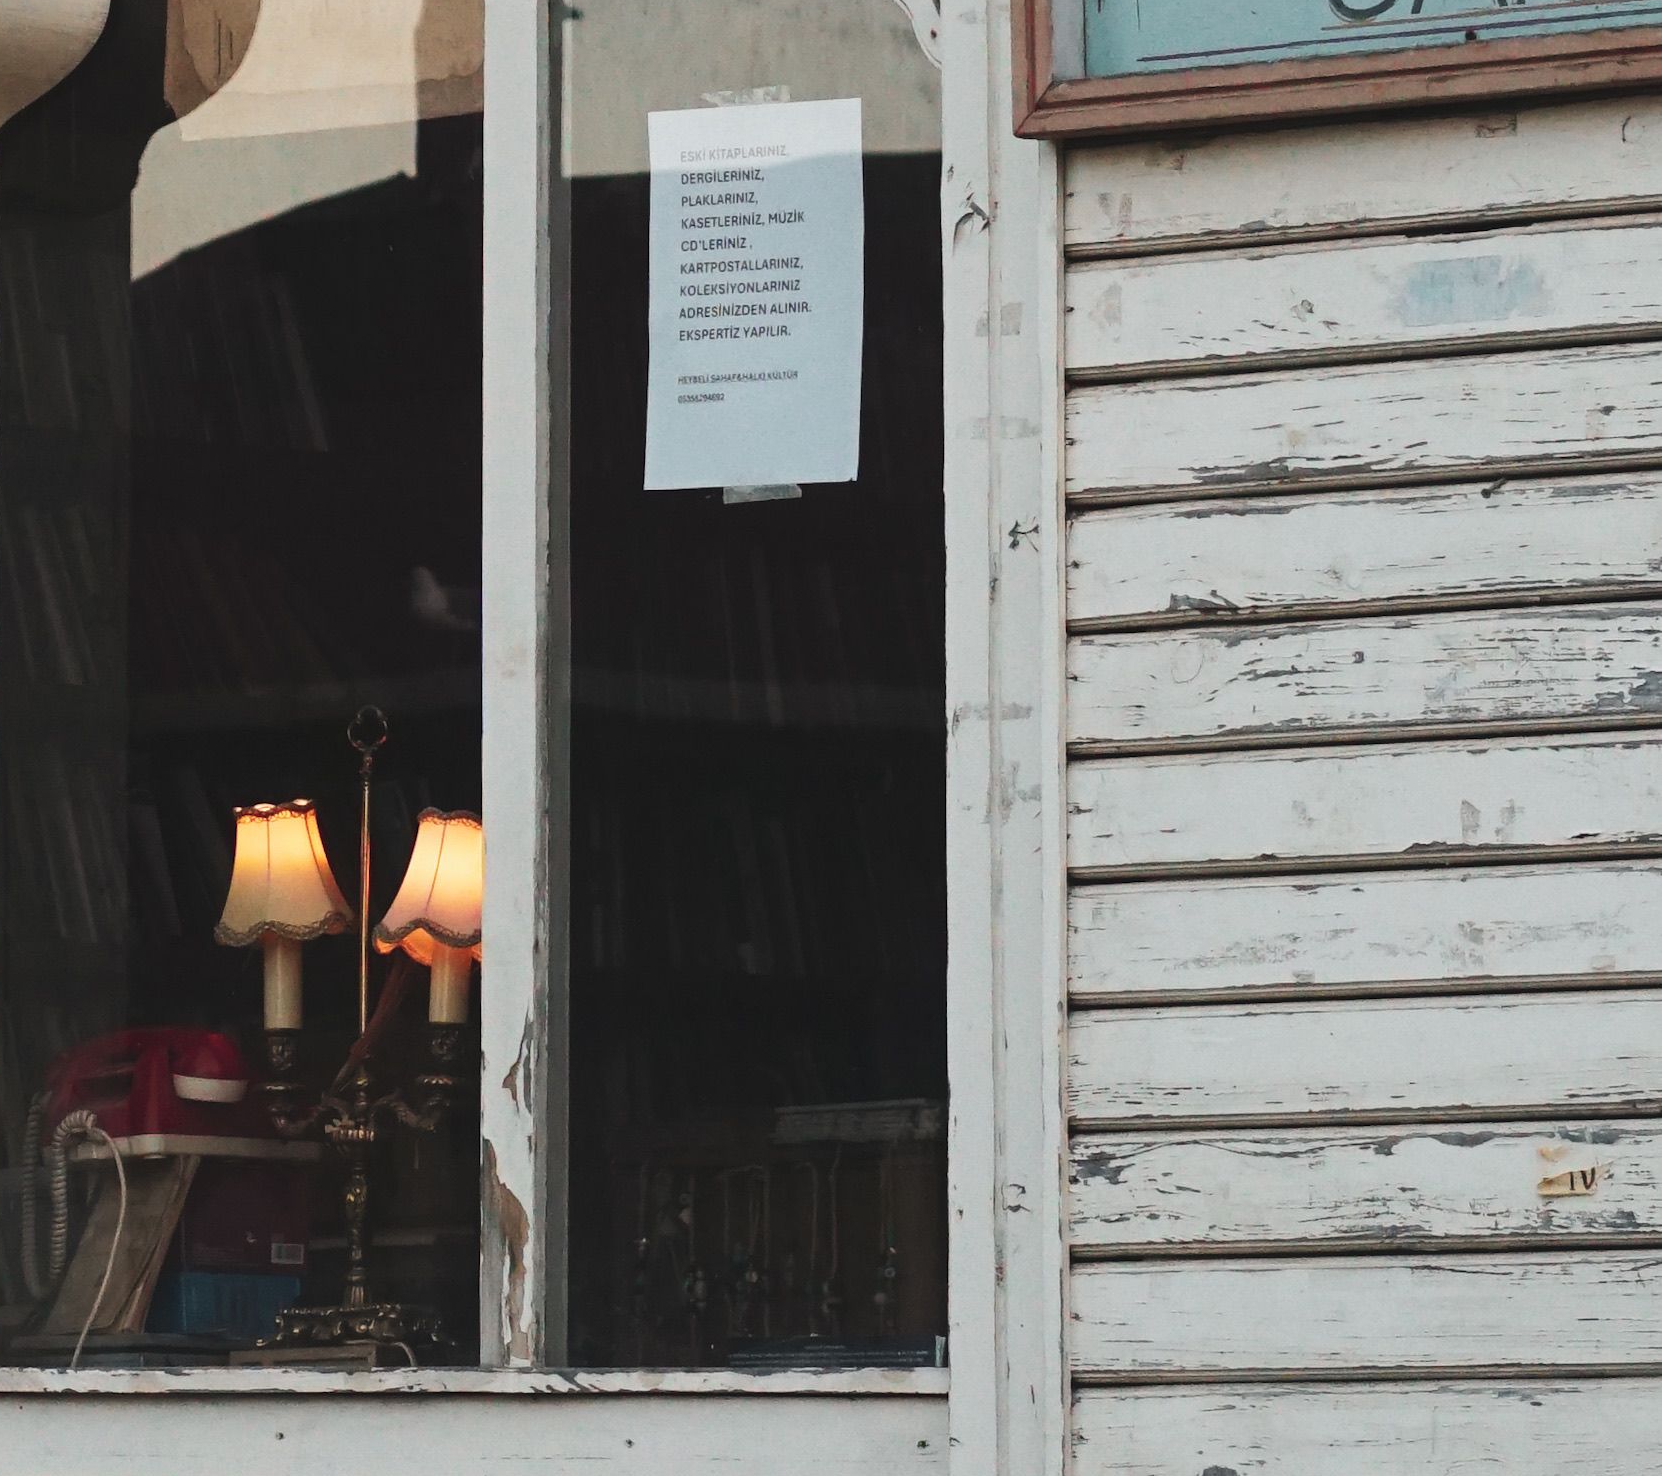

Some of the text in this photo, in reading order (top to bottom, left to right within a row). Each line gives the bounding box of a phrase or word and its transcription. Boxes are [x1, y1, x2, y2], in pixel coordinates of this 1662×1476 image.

[681, 167, 765, 185] DERGİLERİNİZ,
[681, 192, 759, 207] PLAKLARINIZ,
[681, 212, 766, 230] KASETLERİNİZ,
[680, 257, 804, 275] KARTPOSTALLARINIZ,
[680, 279, 801, 297] KOLEKSİYONLARINIZ
[679, 301, 813, 319] ADRESİNİZDEN ALINIR.
[679, 325, 791, 341] EKSPERTİZ YAPILIR.
